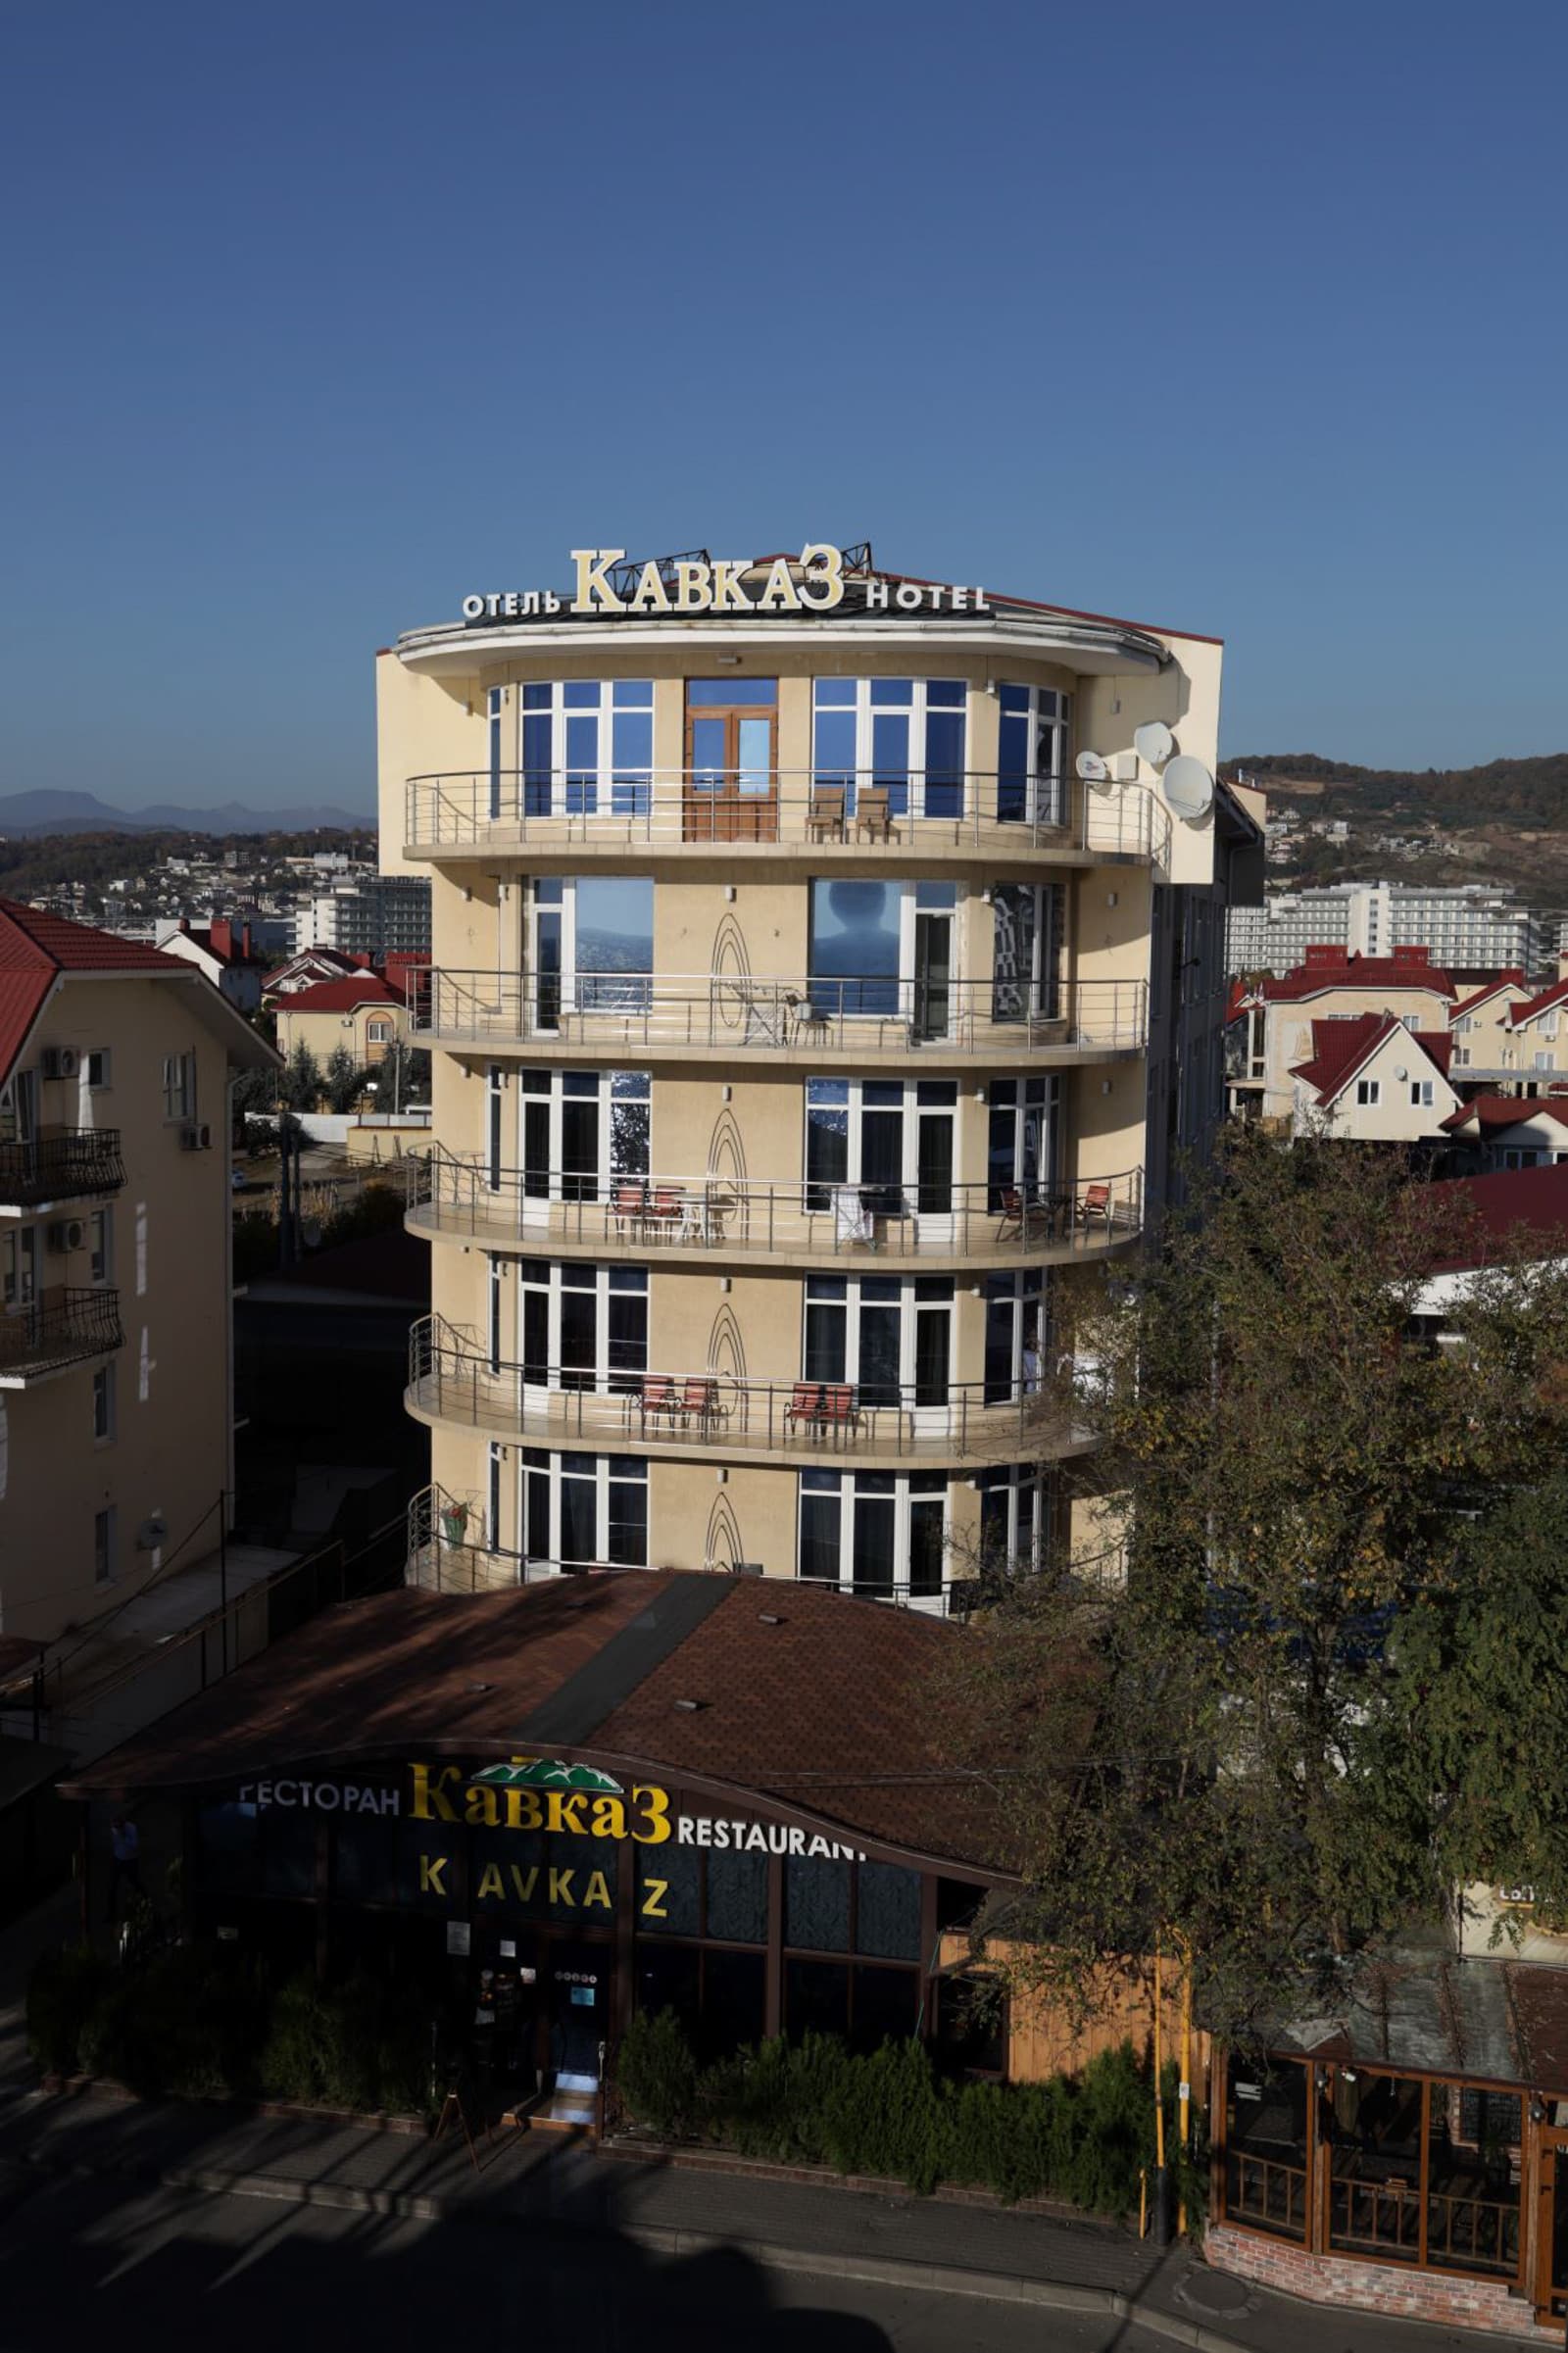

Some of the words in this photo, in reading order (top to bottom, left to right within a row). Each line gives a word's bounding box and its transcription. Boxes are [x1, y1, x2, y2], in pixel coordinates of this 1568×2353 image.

[463, 590, 562, 618] ОТЕЛЬ
[569, 542, 845, 613] КАВКАЗ
[866, 583, 990, 611] HOTEL
